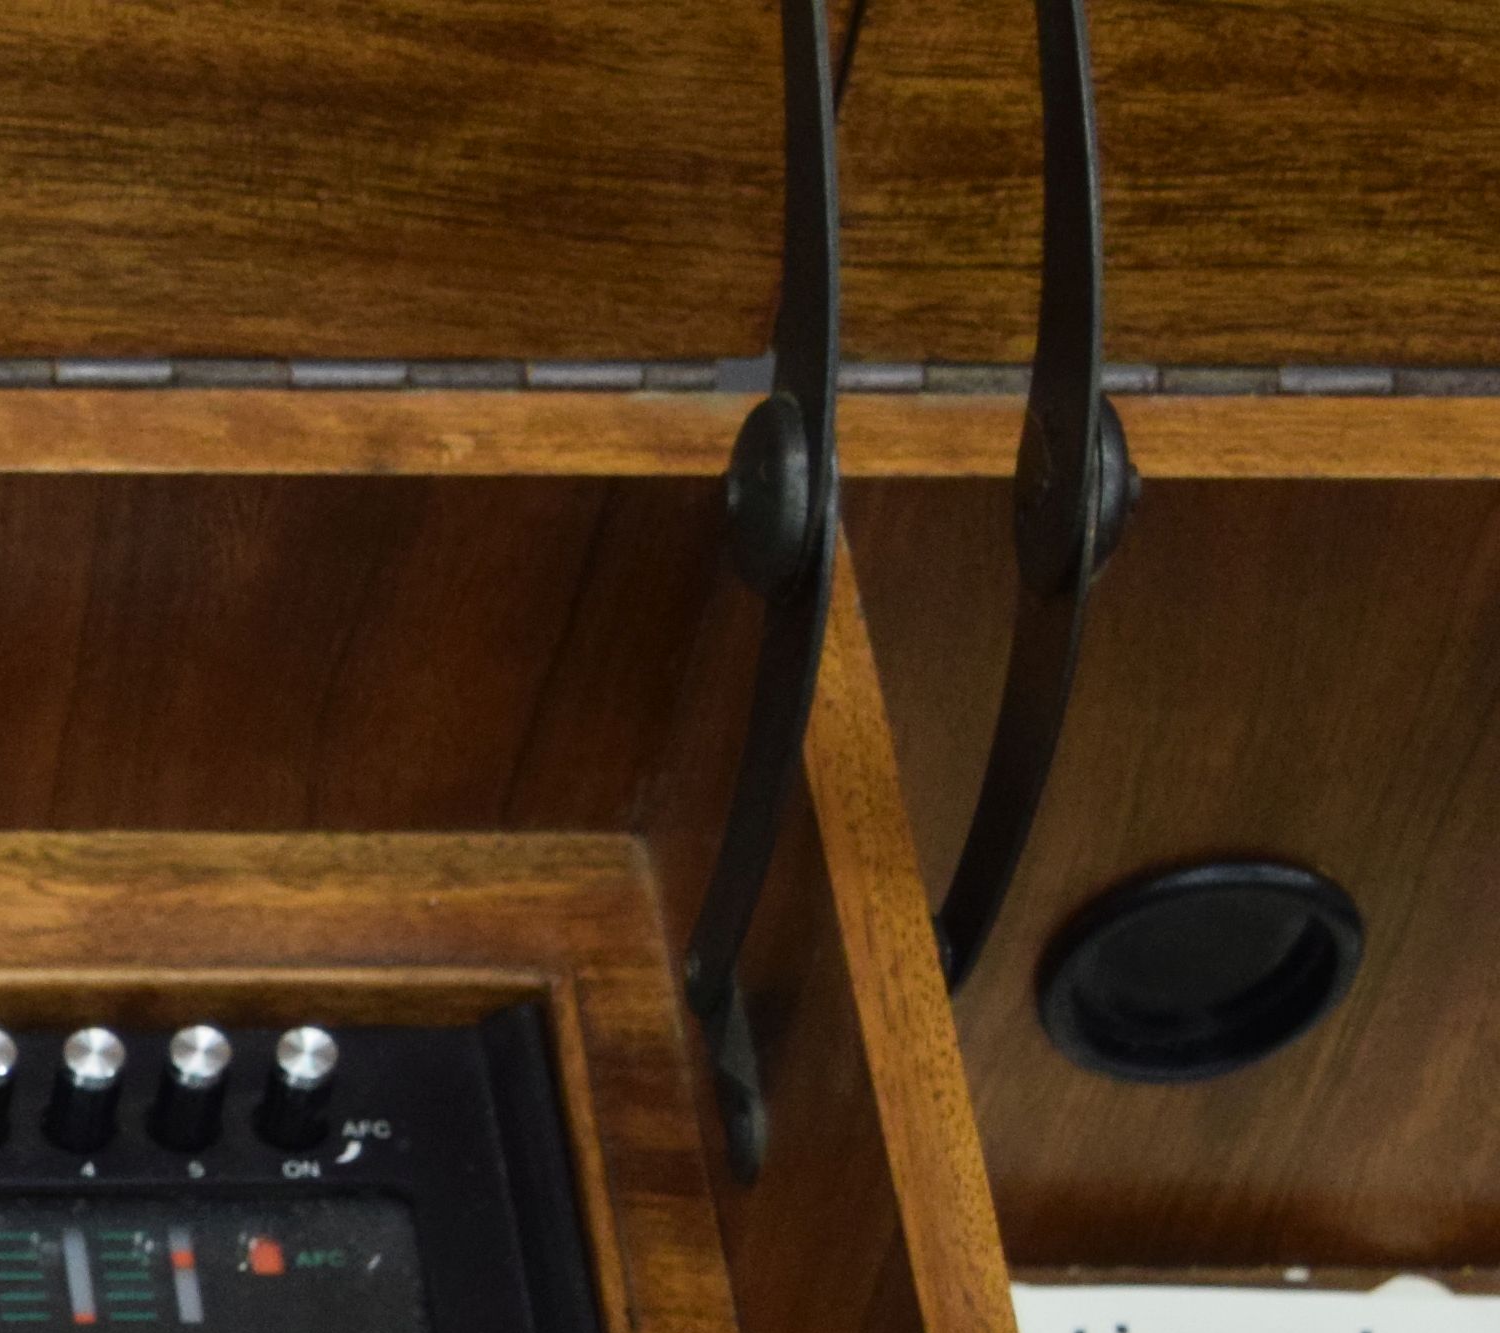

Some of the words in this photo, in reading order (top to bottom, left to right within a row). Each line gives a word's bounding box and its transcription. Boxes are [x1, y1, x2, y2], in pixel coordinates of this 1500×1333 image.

[342, 1120, 392, 1139] AFC
[82, 1162, 95, 1177] 4
[188, 1161, 205, 1178] 5
[282, 1161, 320, 1178] ON
